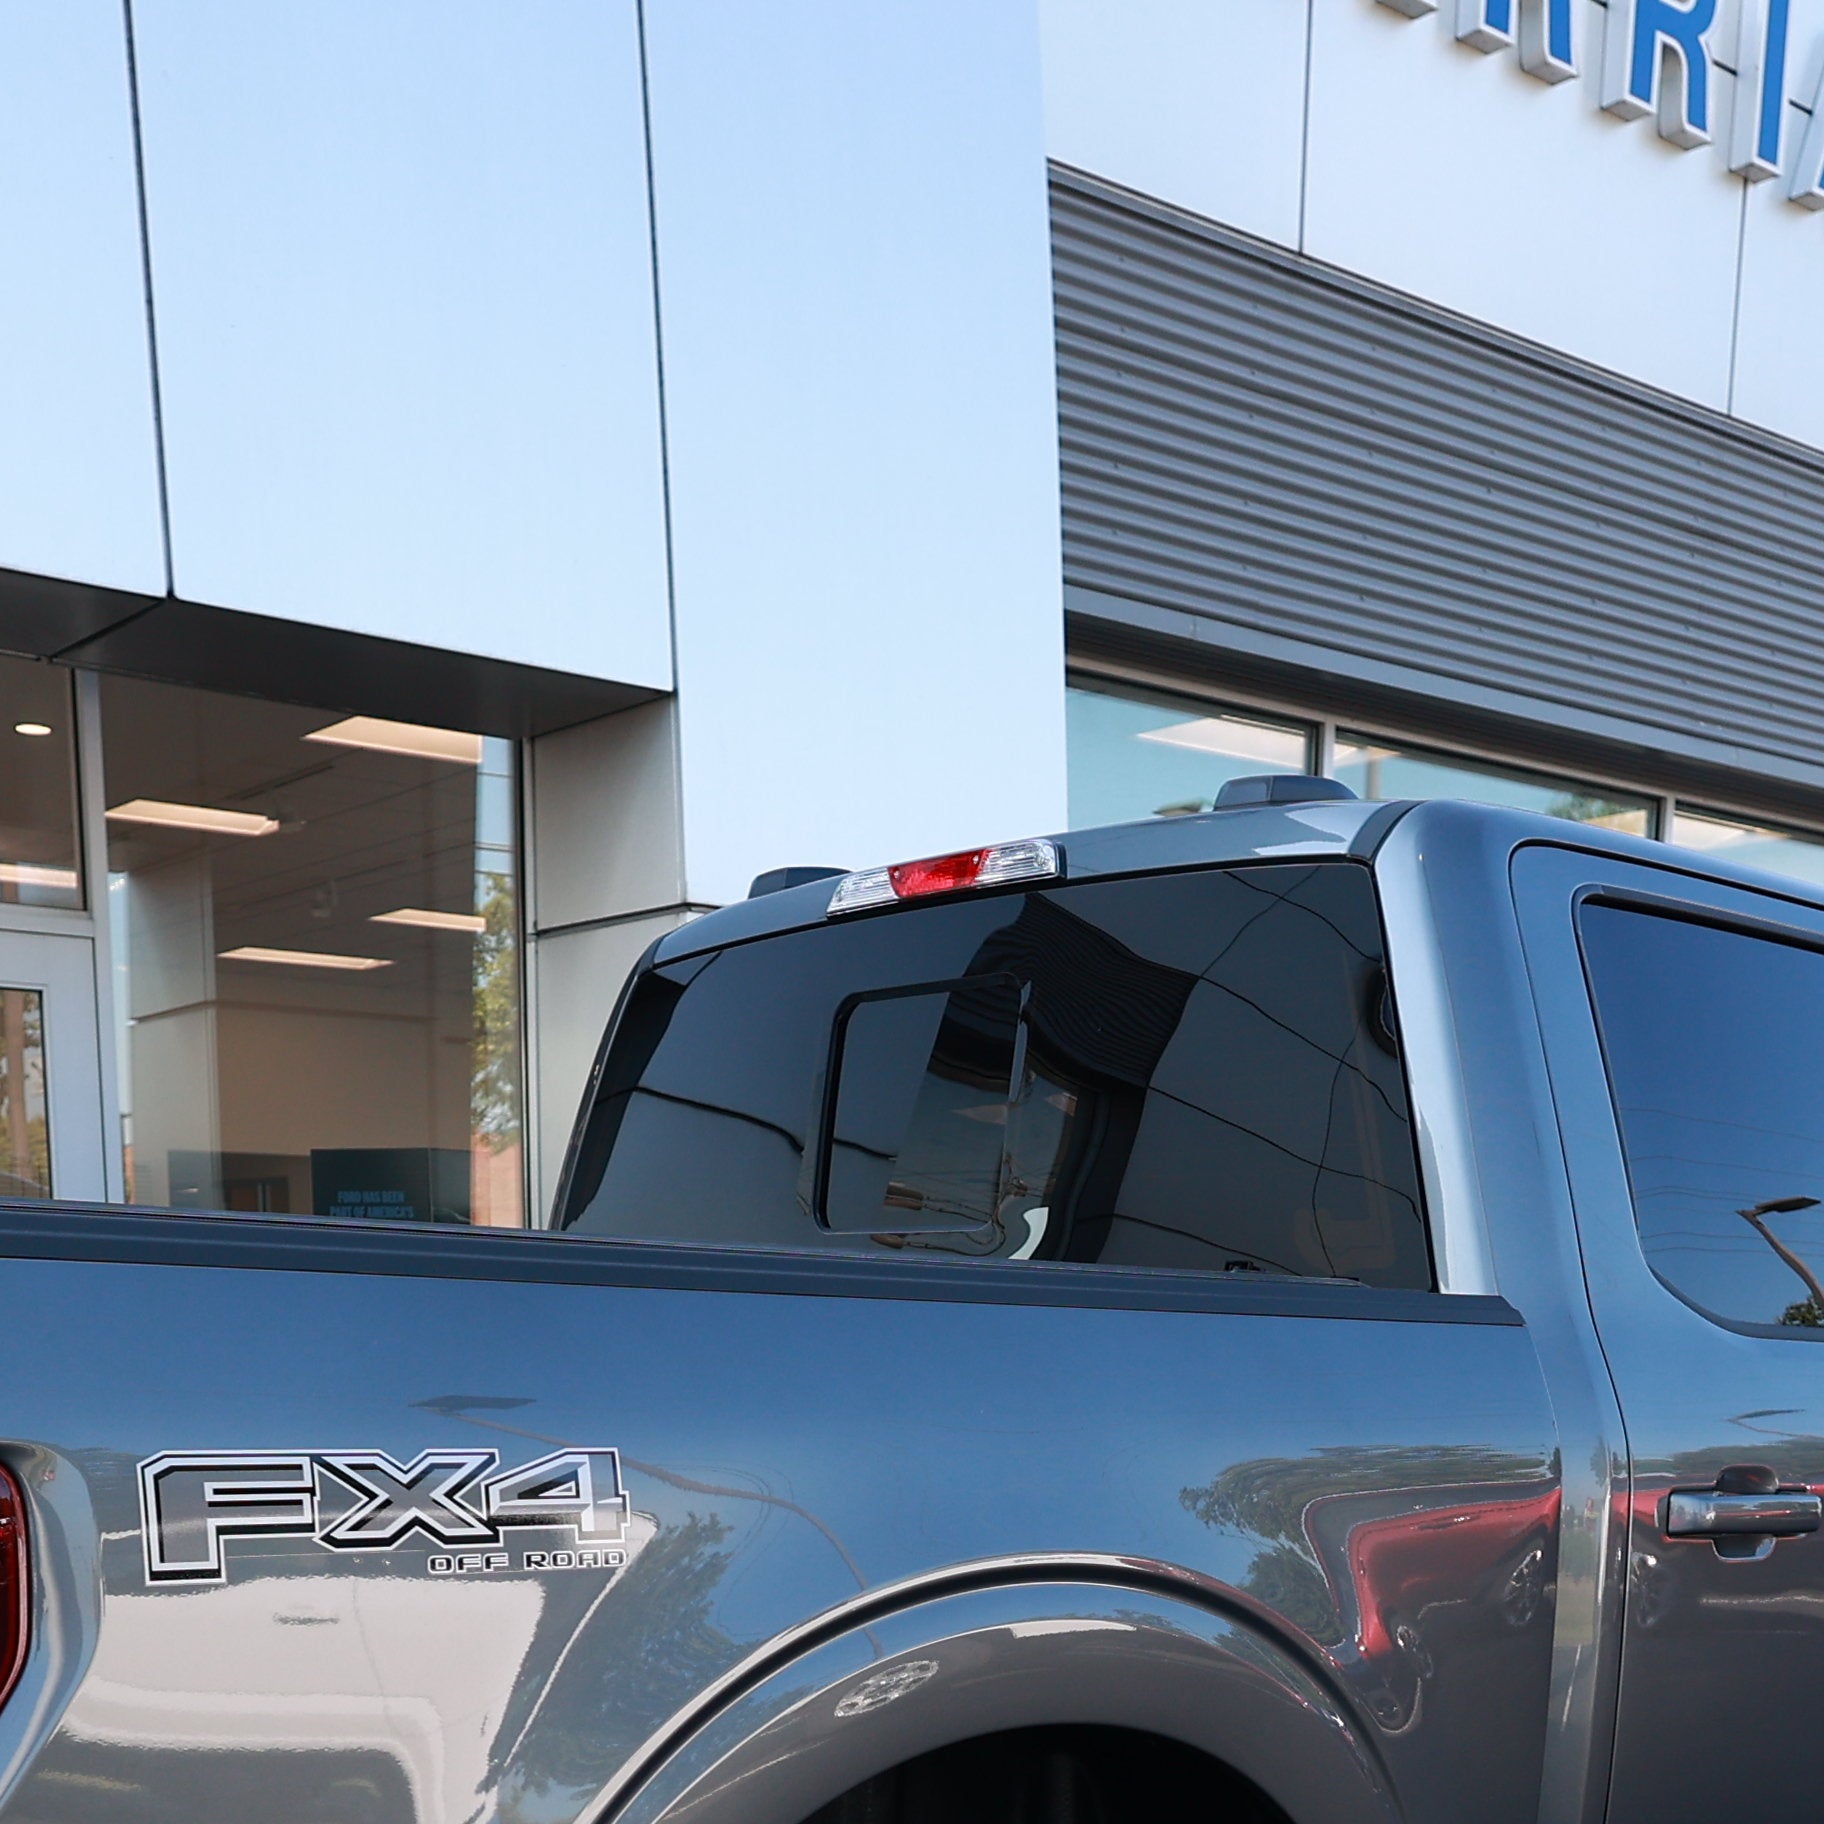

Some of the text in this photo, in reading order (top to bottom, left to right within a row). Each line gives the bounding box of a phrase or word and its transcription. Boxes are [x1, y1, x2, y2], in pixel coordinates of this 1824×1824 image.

[136, 1447, 631, 1587] FX4
[426, 1549, 627, 1574] OFF ROAD
